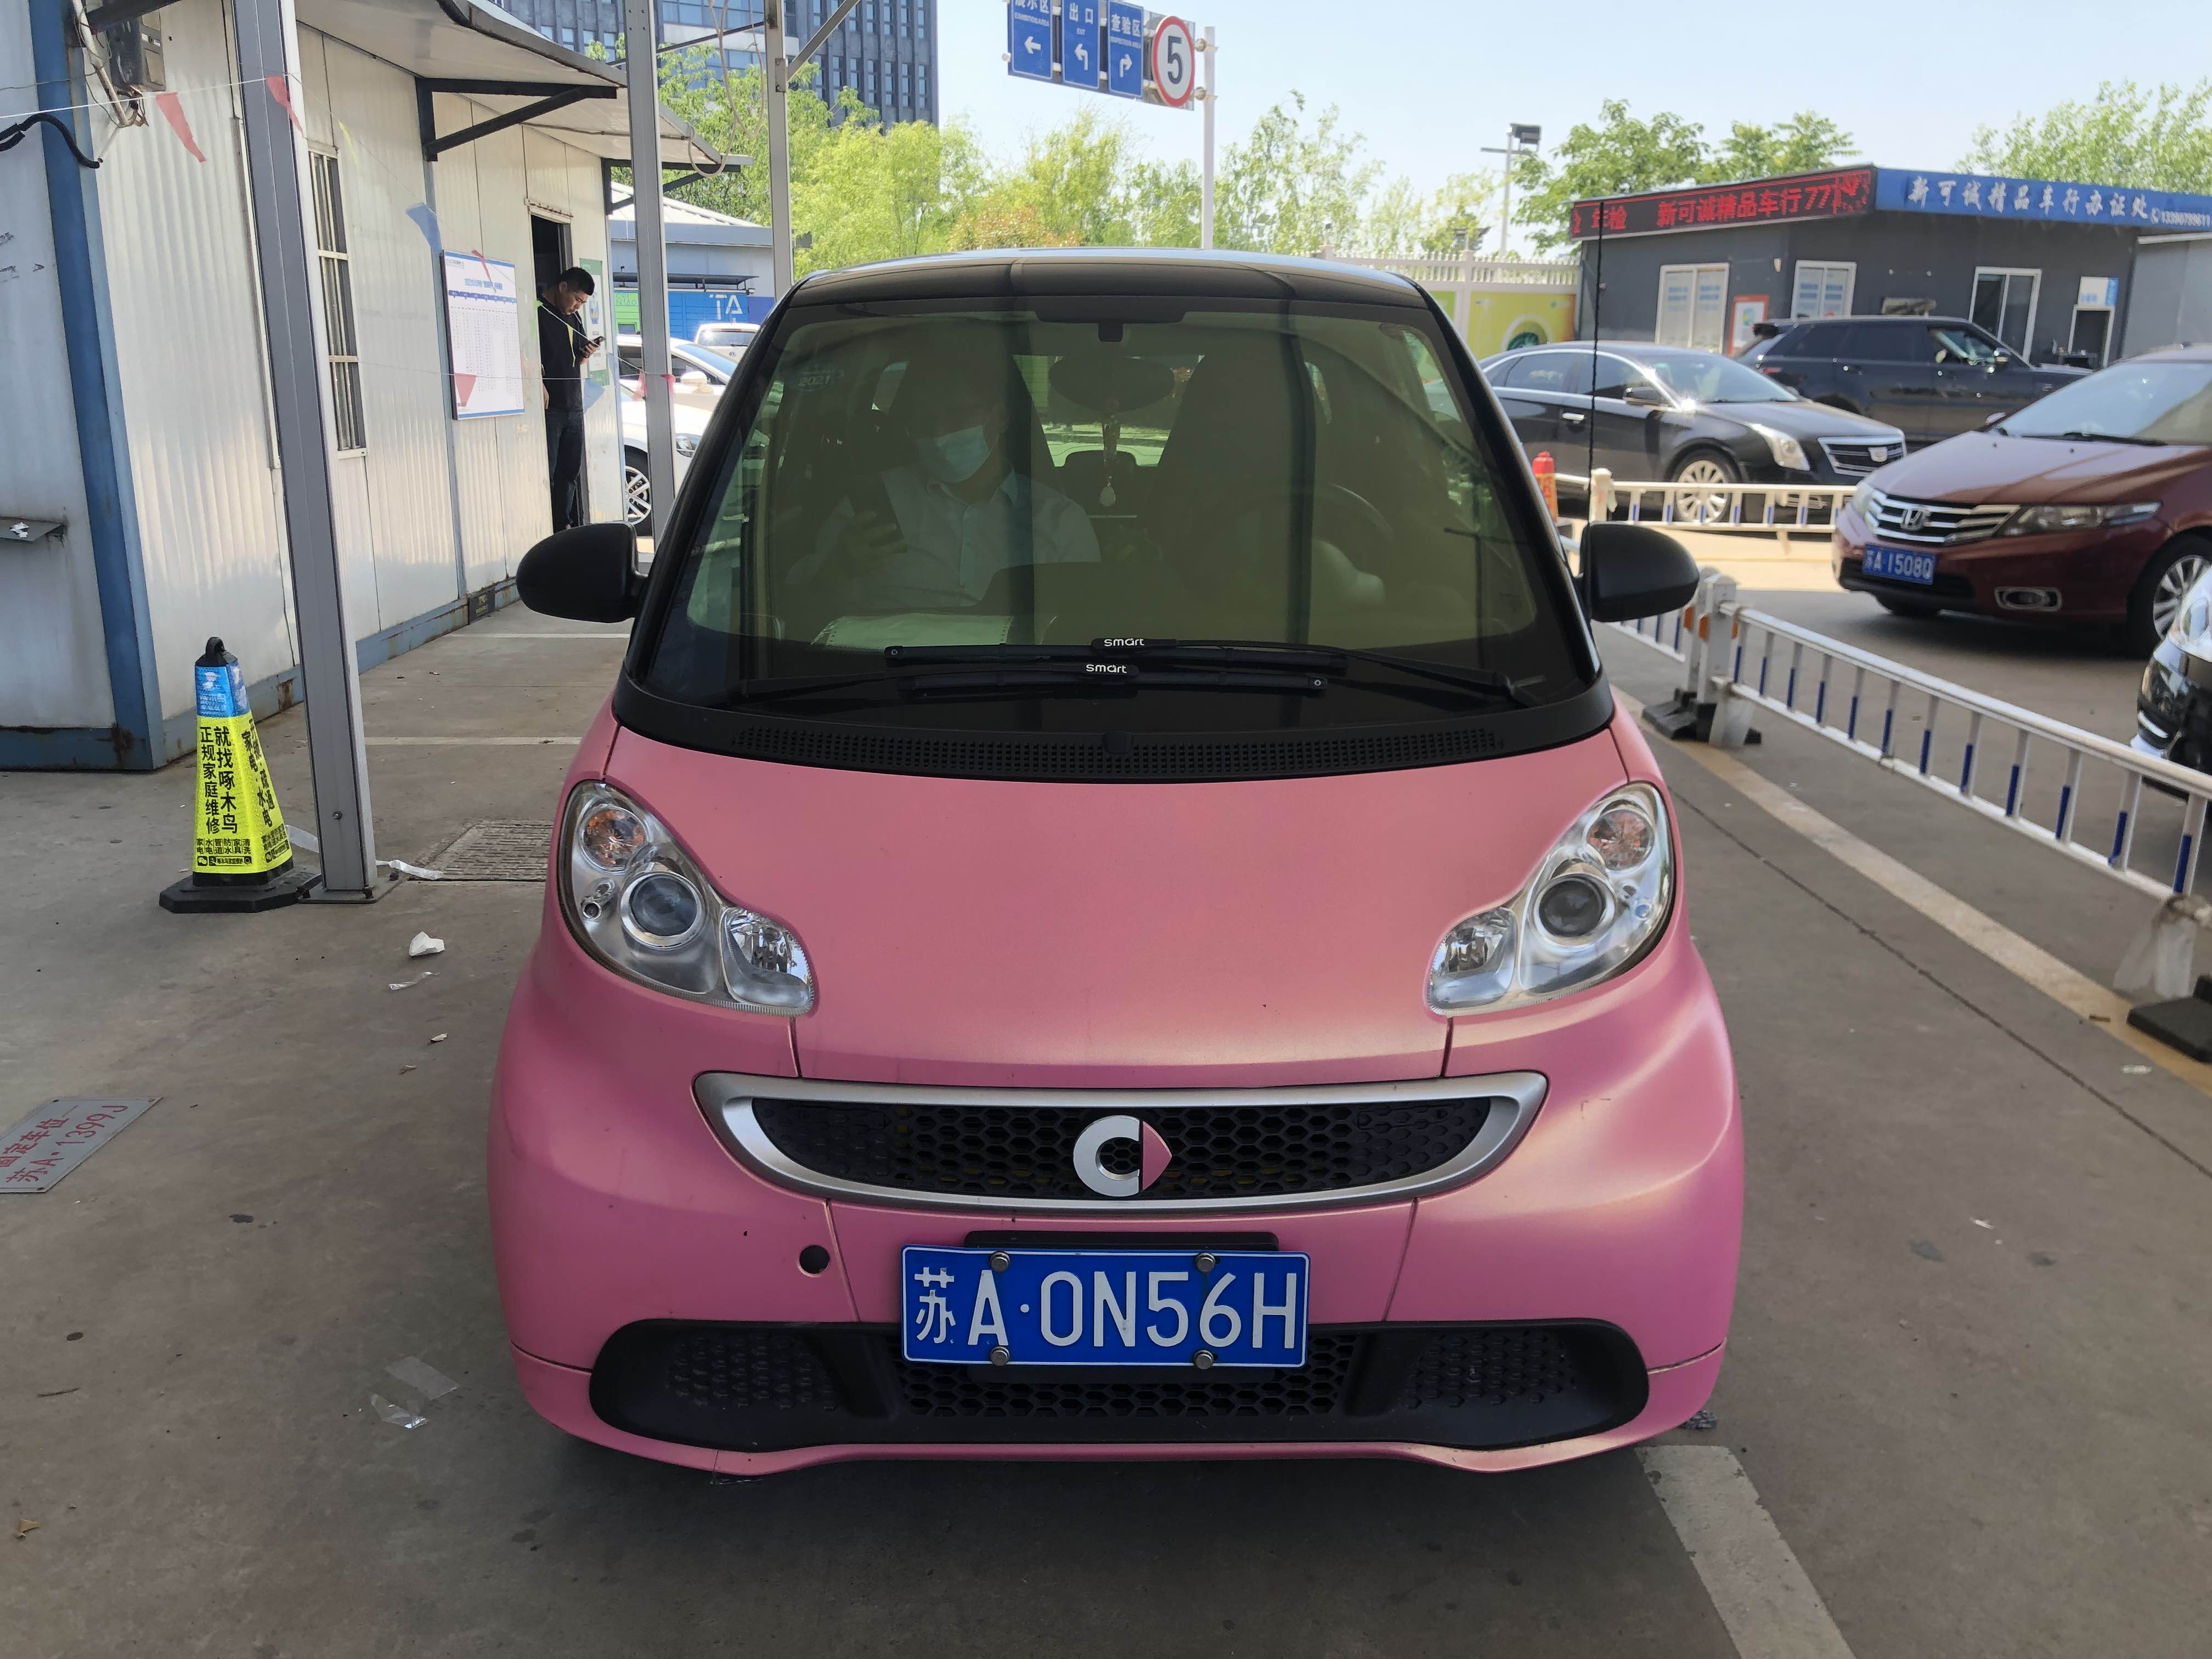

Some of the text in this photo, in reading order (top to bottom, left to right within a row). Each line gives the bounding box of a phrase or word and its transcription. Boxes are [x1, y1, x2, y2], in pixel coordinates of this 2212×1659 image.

[1069, 2, 1093, 25] 出口
[1111, 14, 1141, 37] 查验区
[1167, 35, 1183, 84] 5
[1104, 638, 1145, 646] smart
[1086, 664, 1127, 674] smart
[200, 726, 221, 834] 正规家庭维修
[213, 726, 238, 834] 就找啄木鸟
[914, 1267, 1297, 1349] 苏A·0N56H
